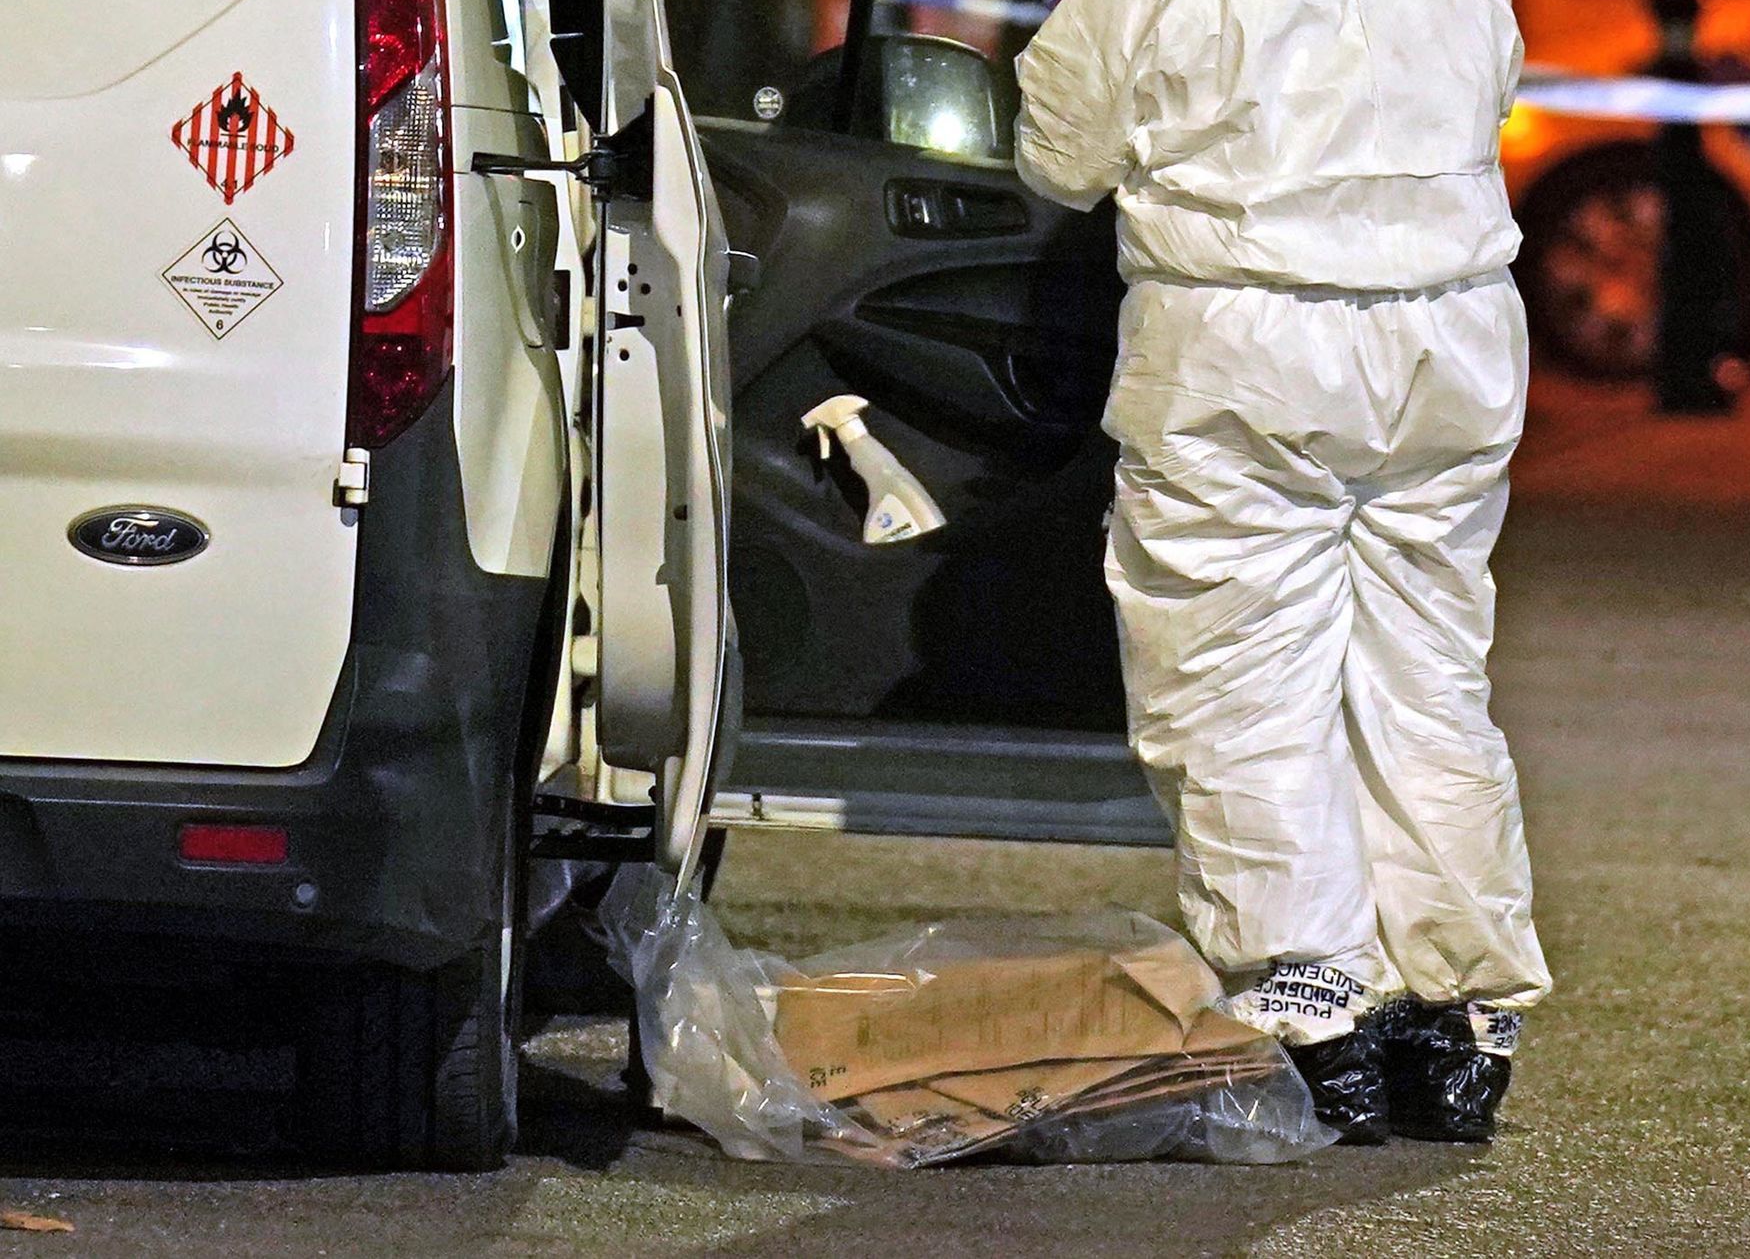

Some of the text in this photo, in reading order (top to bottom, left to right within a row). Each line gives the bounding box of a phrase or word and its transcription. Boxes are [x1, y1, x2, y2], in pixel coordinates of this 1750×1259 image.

[170, 275, 275, 289] INFECTIOUS SUBSTANCE
[215, 318, 224, 330] 6
[101, 517, 178, 551] Ford
[1260, 997, 1332, 1020] POLICE
